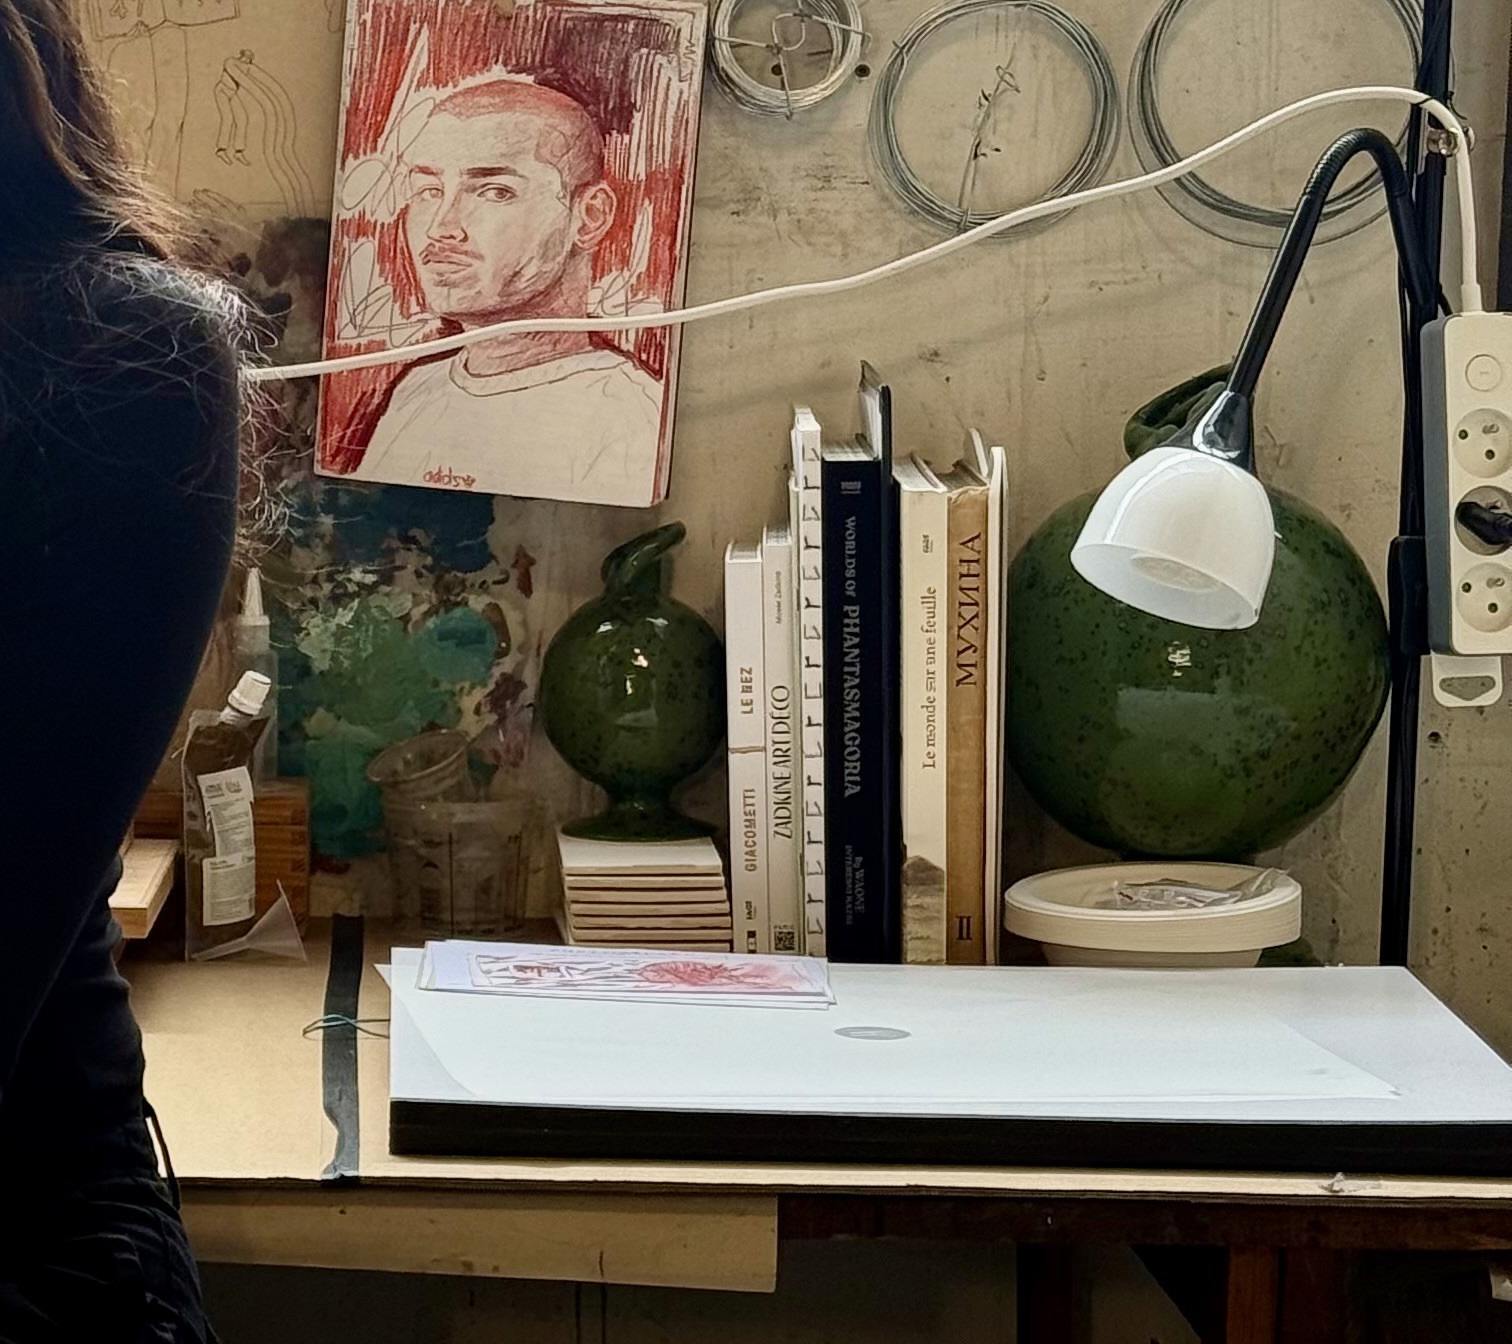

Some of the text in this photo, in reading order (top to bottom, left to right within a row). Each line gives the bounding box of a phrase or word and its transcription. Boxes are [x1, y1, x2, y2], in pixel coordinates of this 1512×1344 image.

[844, 515, 857, 578] WORLDS
[955, 532, 982, 687] МУХИНА
[739, 666, 754, 715] LE NEZ
[842, 605, 862, 798] PHANTASMAGORIA
[920, 585, 937, 769] Le monde sur une feuille
[743, 788, 758, 872] GIACOMETTI
[768, 685, 793, 840] ZADKINE ART DÉCO
